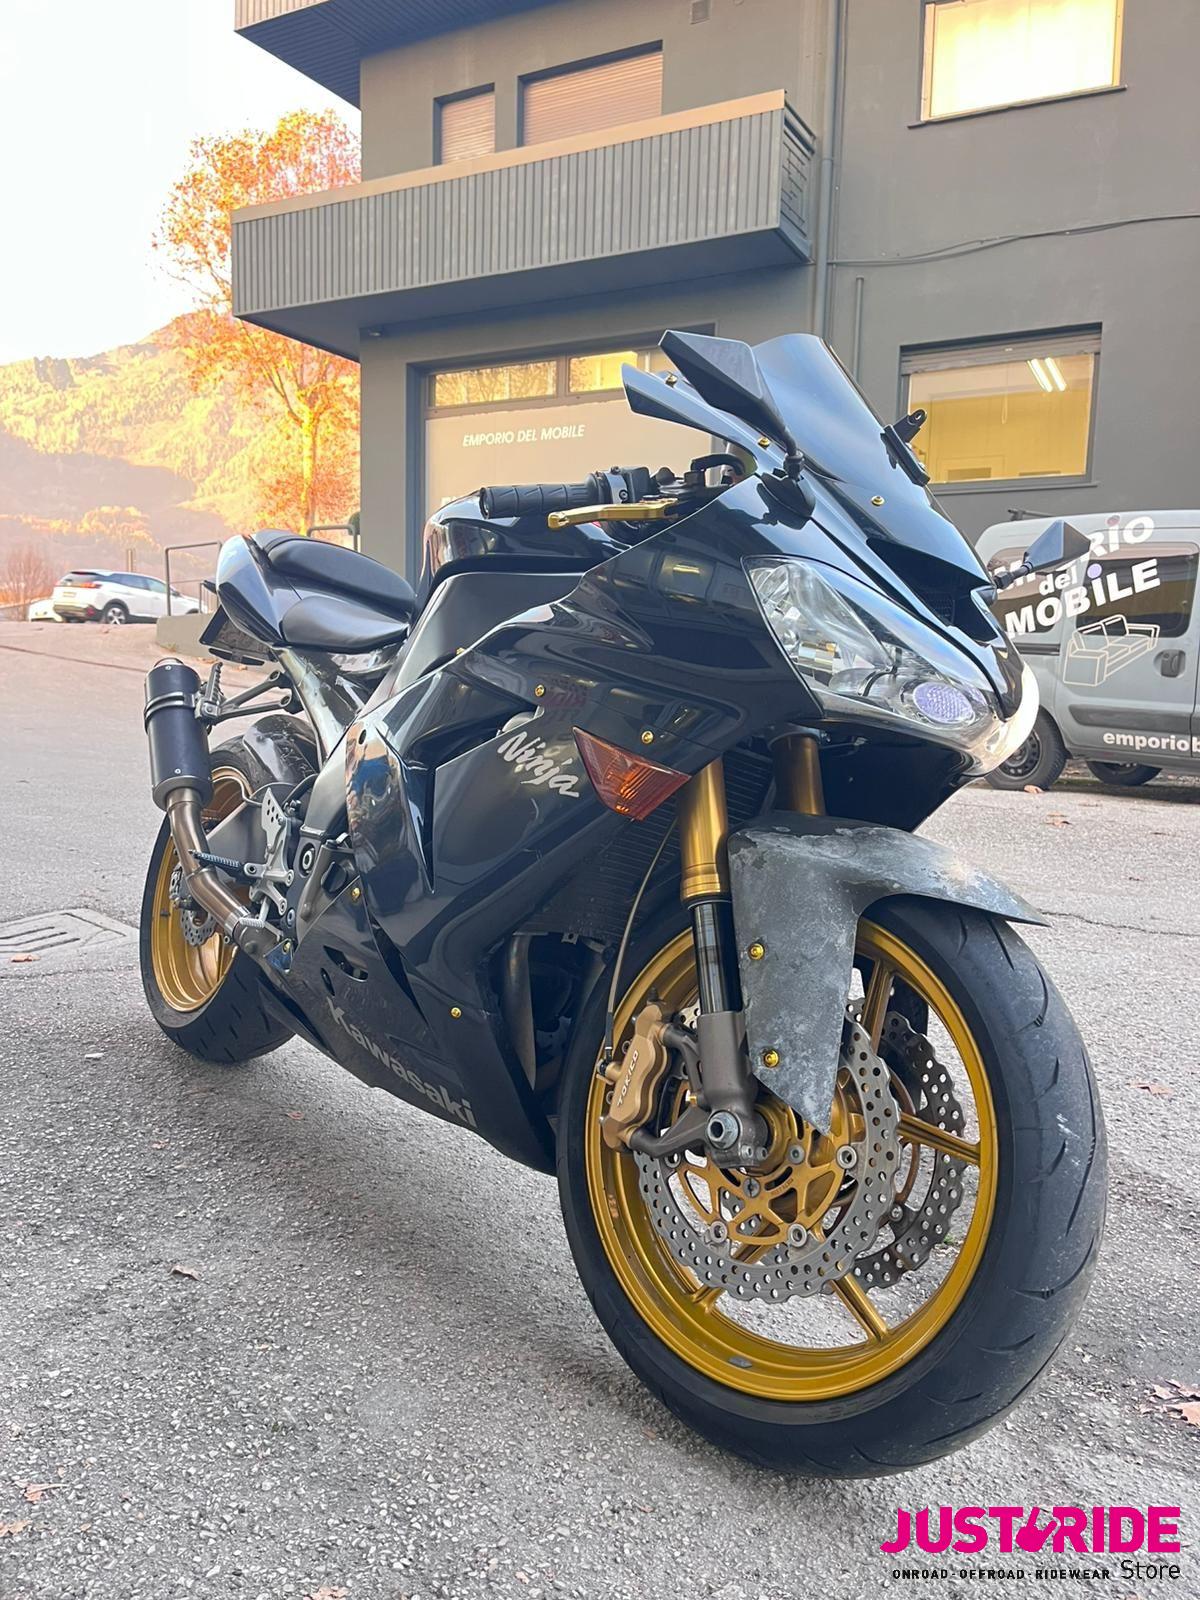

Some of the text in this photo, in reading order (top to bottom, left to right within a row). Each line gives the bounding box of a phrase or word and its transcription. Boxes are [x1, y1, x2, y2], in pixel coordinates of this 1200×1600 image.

[463, 424, 586, 447] EMPORIO DEL MOBILE
[1039, 565, 1077, 596] del
[497, 731, 580, 798] Ninja
[326, 996, 478, 1128] Kawasaki
[617, 1050, 639, 1106] TOKICO
